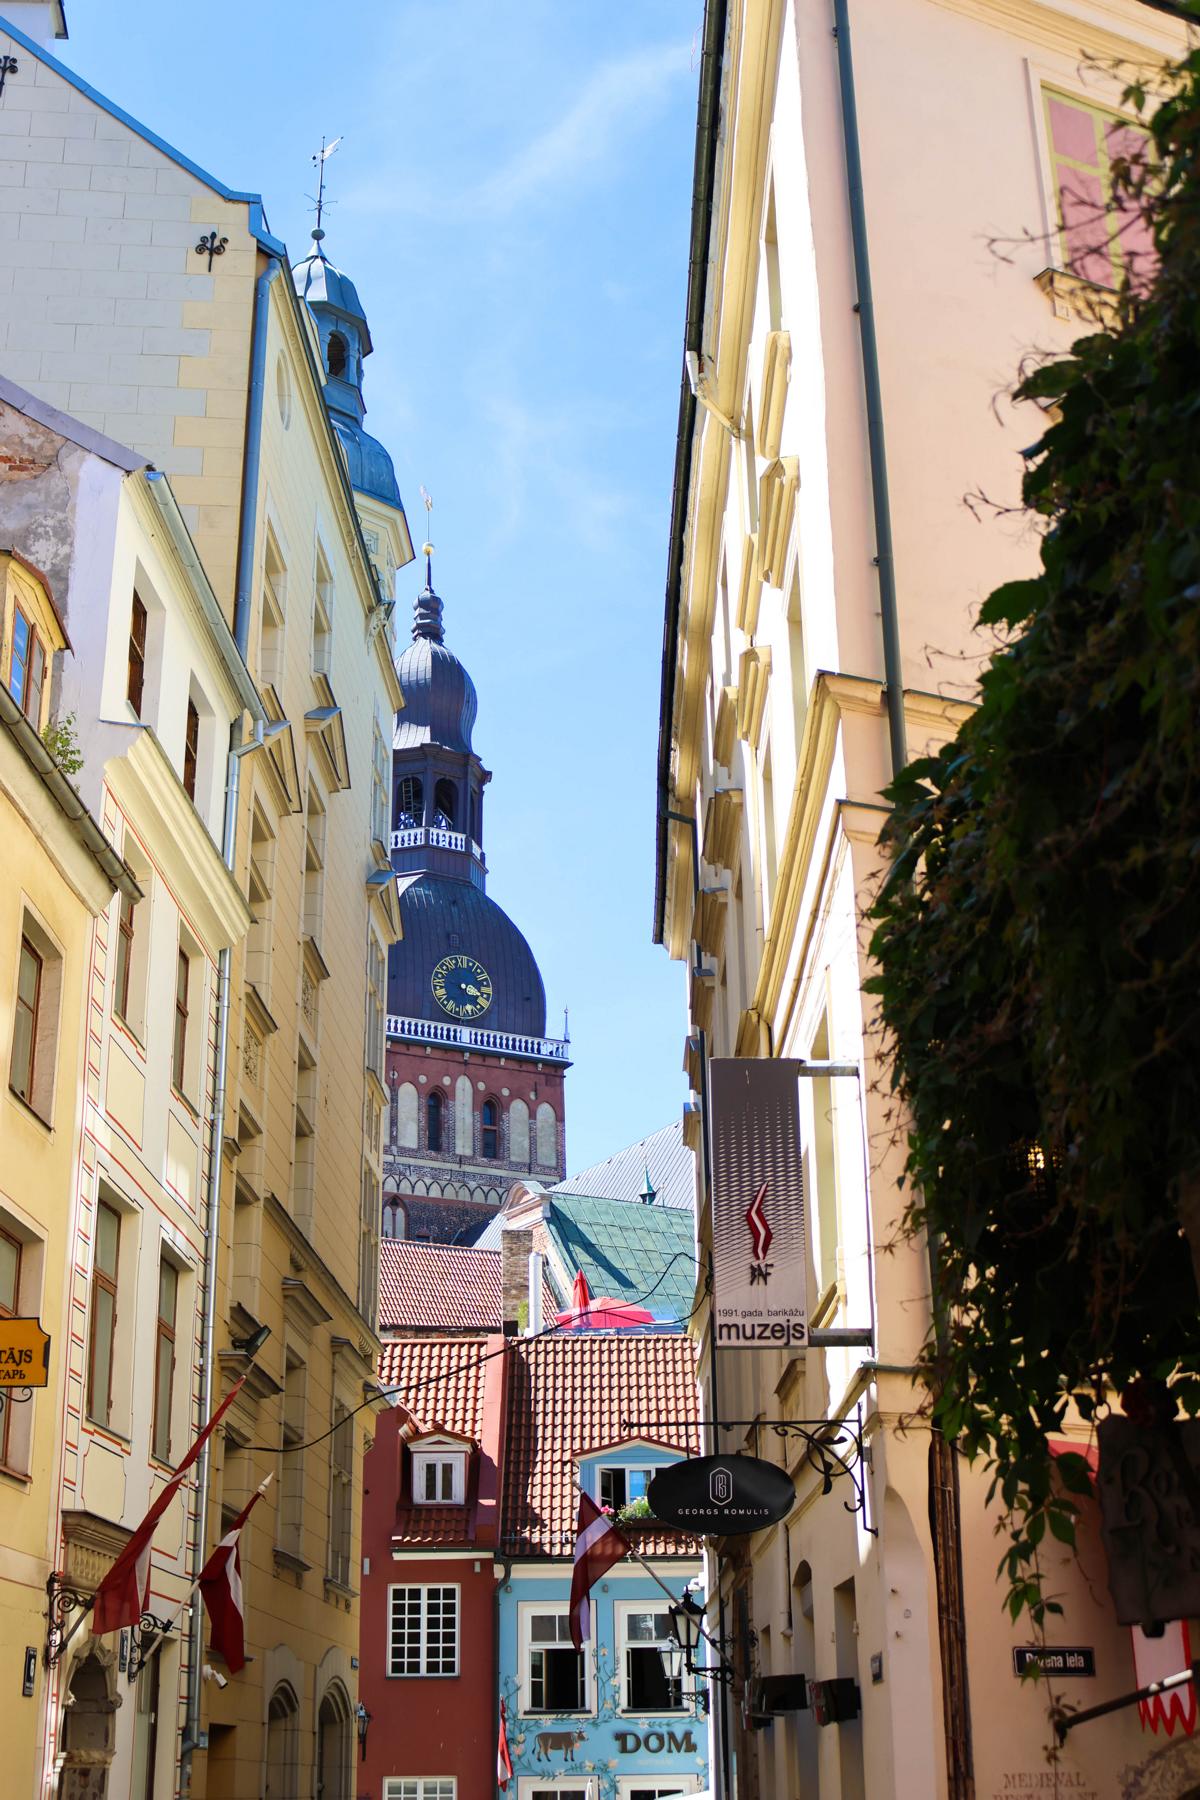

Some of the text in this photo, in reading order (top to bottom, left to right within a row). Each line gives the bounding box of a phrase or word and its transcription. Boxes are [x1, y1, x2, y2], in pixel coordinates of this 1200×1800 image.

[741, 1309, 763, 1319] gada
[718, 1319, 805, 1346] muzejs
[1065, 1652, 1085, 1668] iela
[614, 1730, 698, 1753] DOM
[1003, 1772, 1087, 1789] MEDIEVAL
